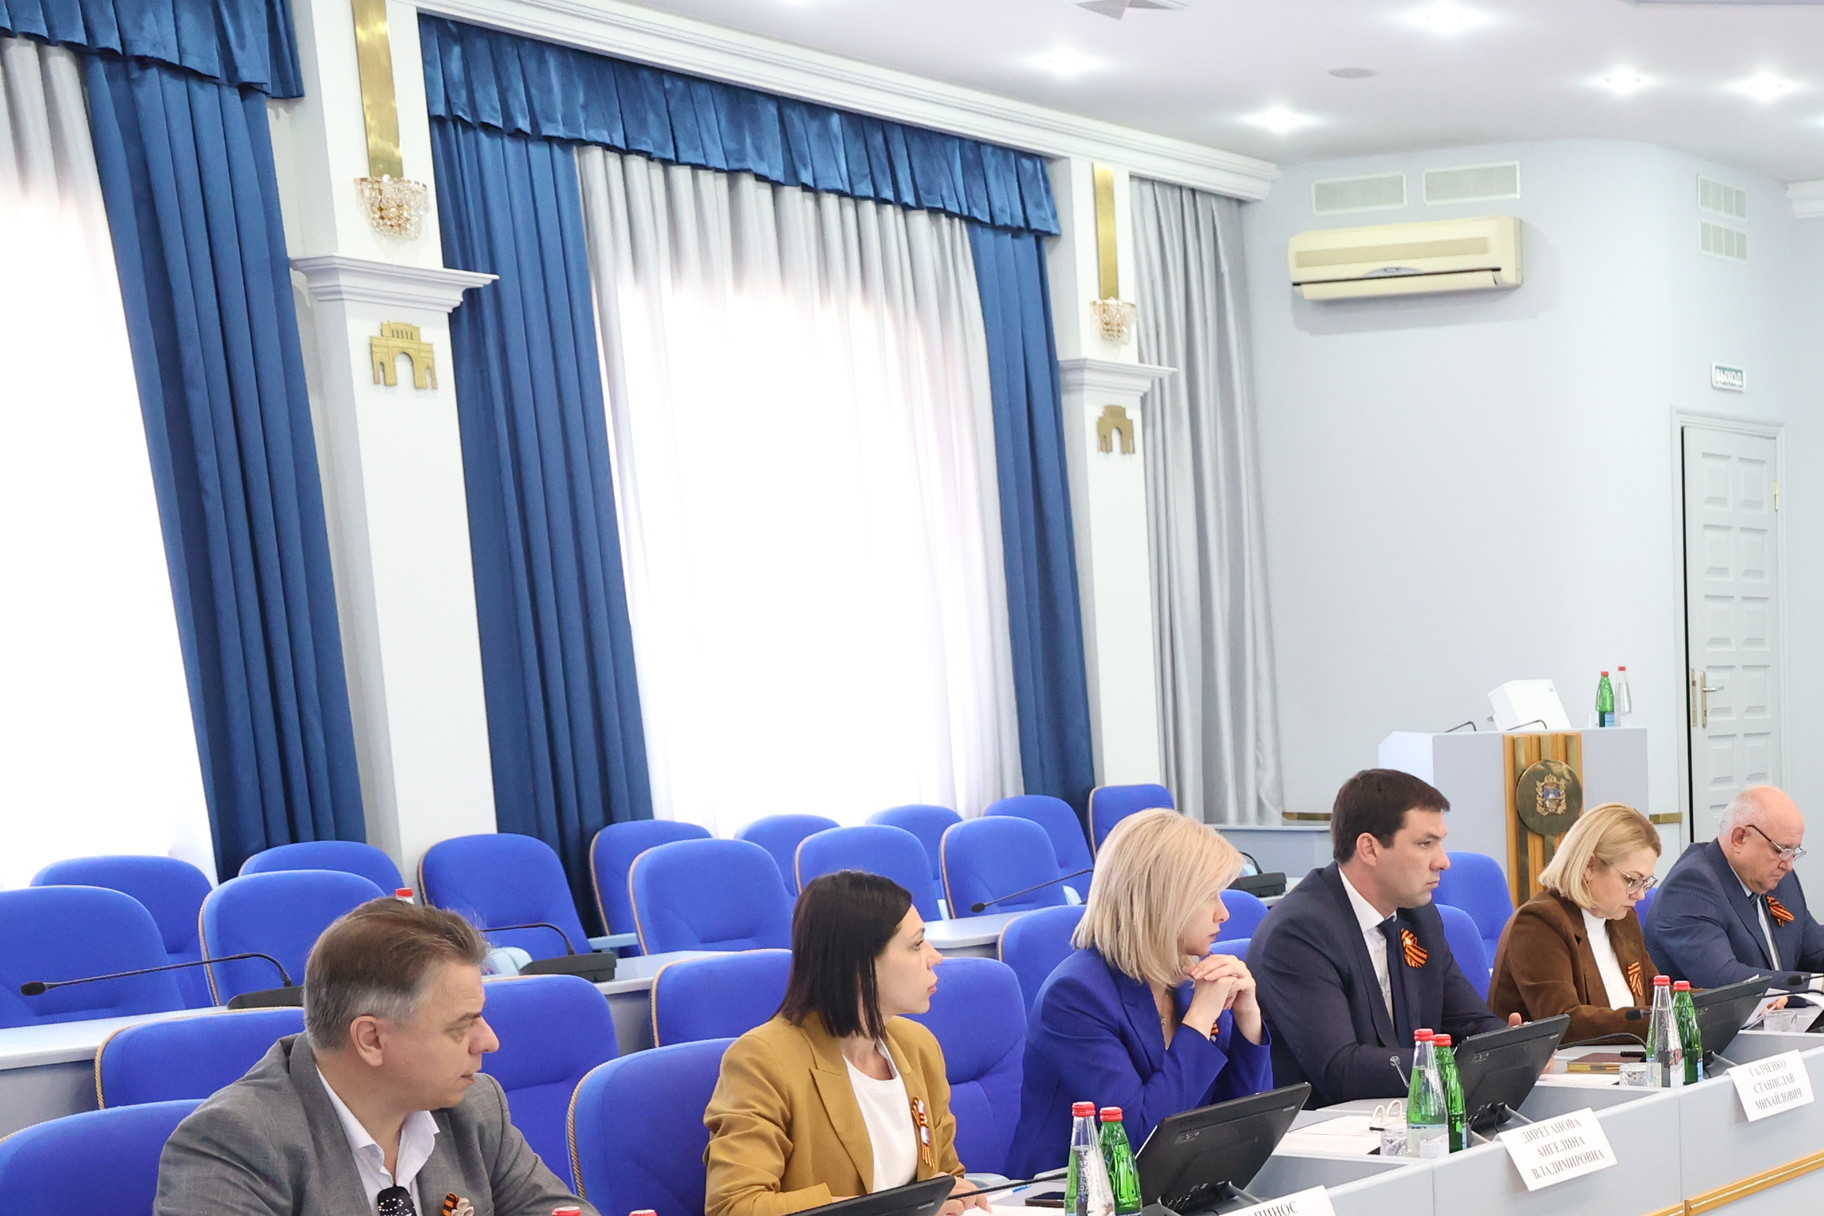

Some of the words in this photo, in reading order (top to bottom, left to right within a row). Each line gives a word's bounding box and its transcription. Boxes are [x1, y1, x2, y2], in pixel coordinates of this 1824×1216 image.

[1715, 369, 1743, 386] ВЫХОД
[1749, 1058, 1787, 1077] ГАЛЧЕНКО
[1753, 1073, 1796, 1094] СТАНИСЛАВ
[1755, 1087, 1803, 1110] МИХАЙЛОВИЧ
[1521, 1118, 1582, 1144] ДИРЕГАНОВА
[1537, 1135, 1586, 1158] АНГЕЛИНА
[1531, 1149, 1605, 1180] ВЛАДИМИРОВНА
